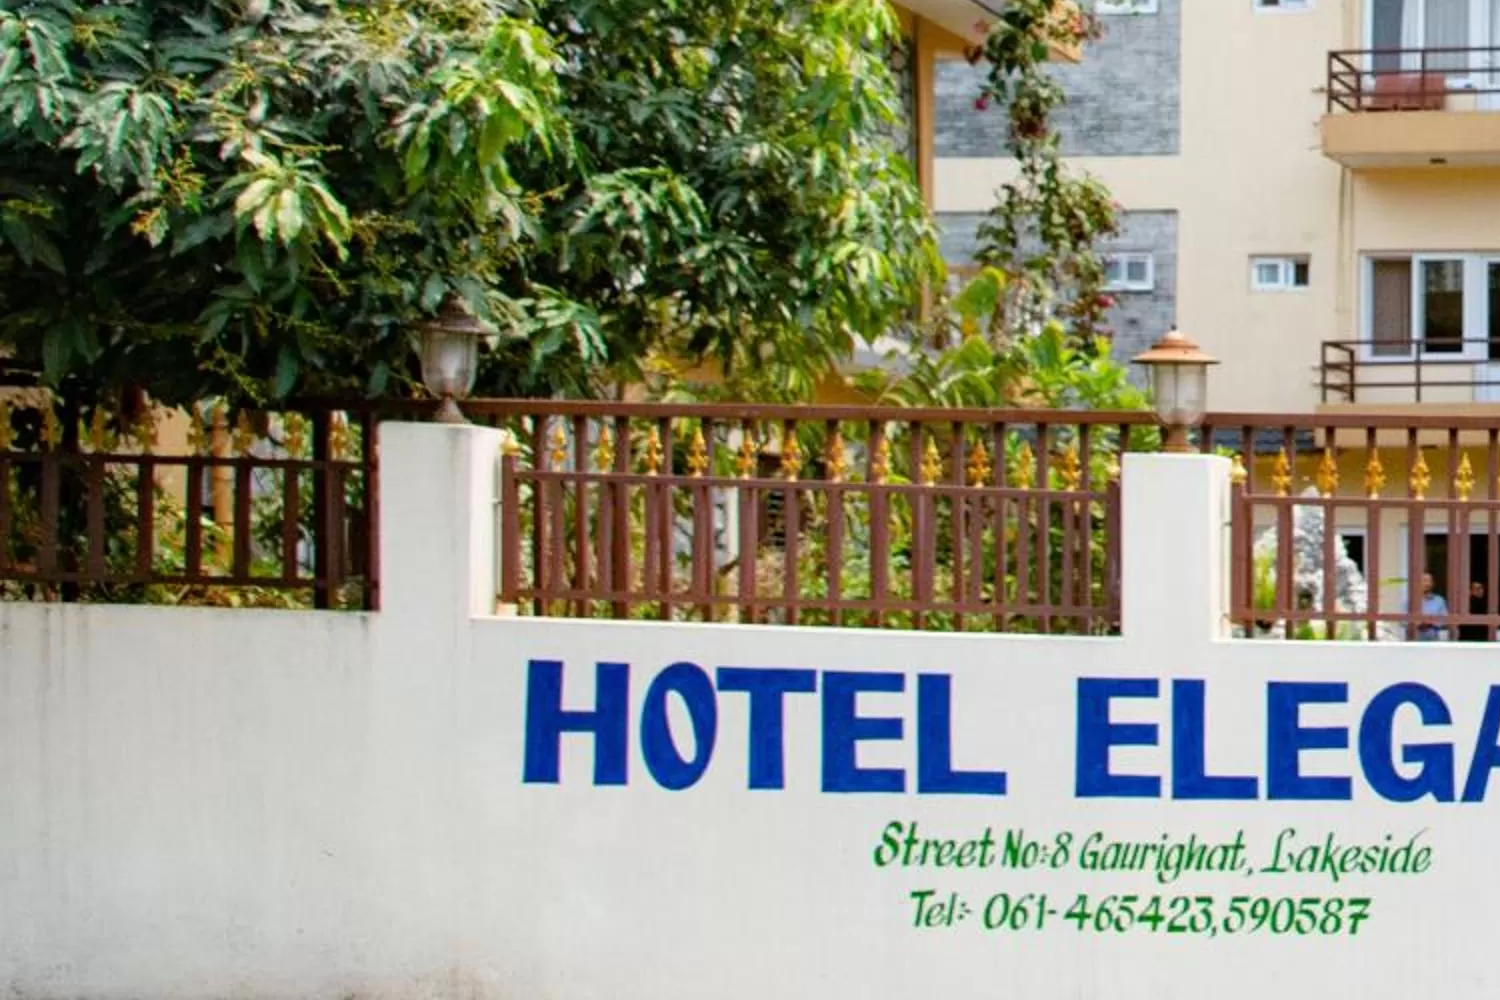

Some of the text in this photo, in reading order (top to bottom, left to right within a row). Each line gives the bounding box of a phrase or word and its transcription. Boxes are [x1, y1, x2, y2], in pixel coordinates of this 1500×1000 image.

[522, 658, 1008, 796] HOTEL
[873, 820, 995, 868] Street
[1079, 829, 1253, 884] Gaurighat,
[1259, 826, 1432, 882] Lakeside
